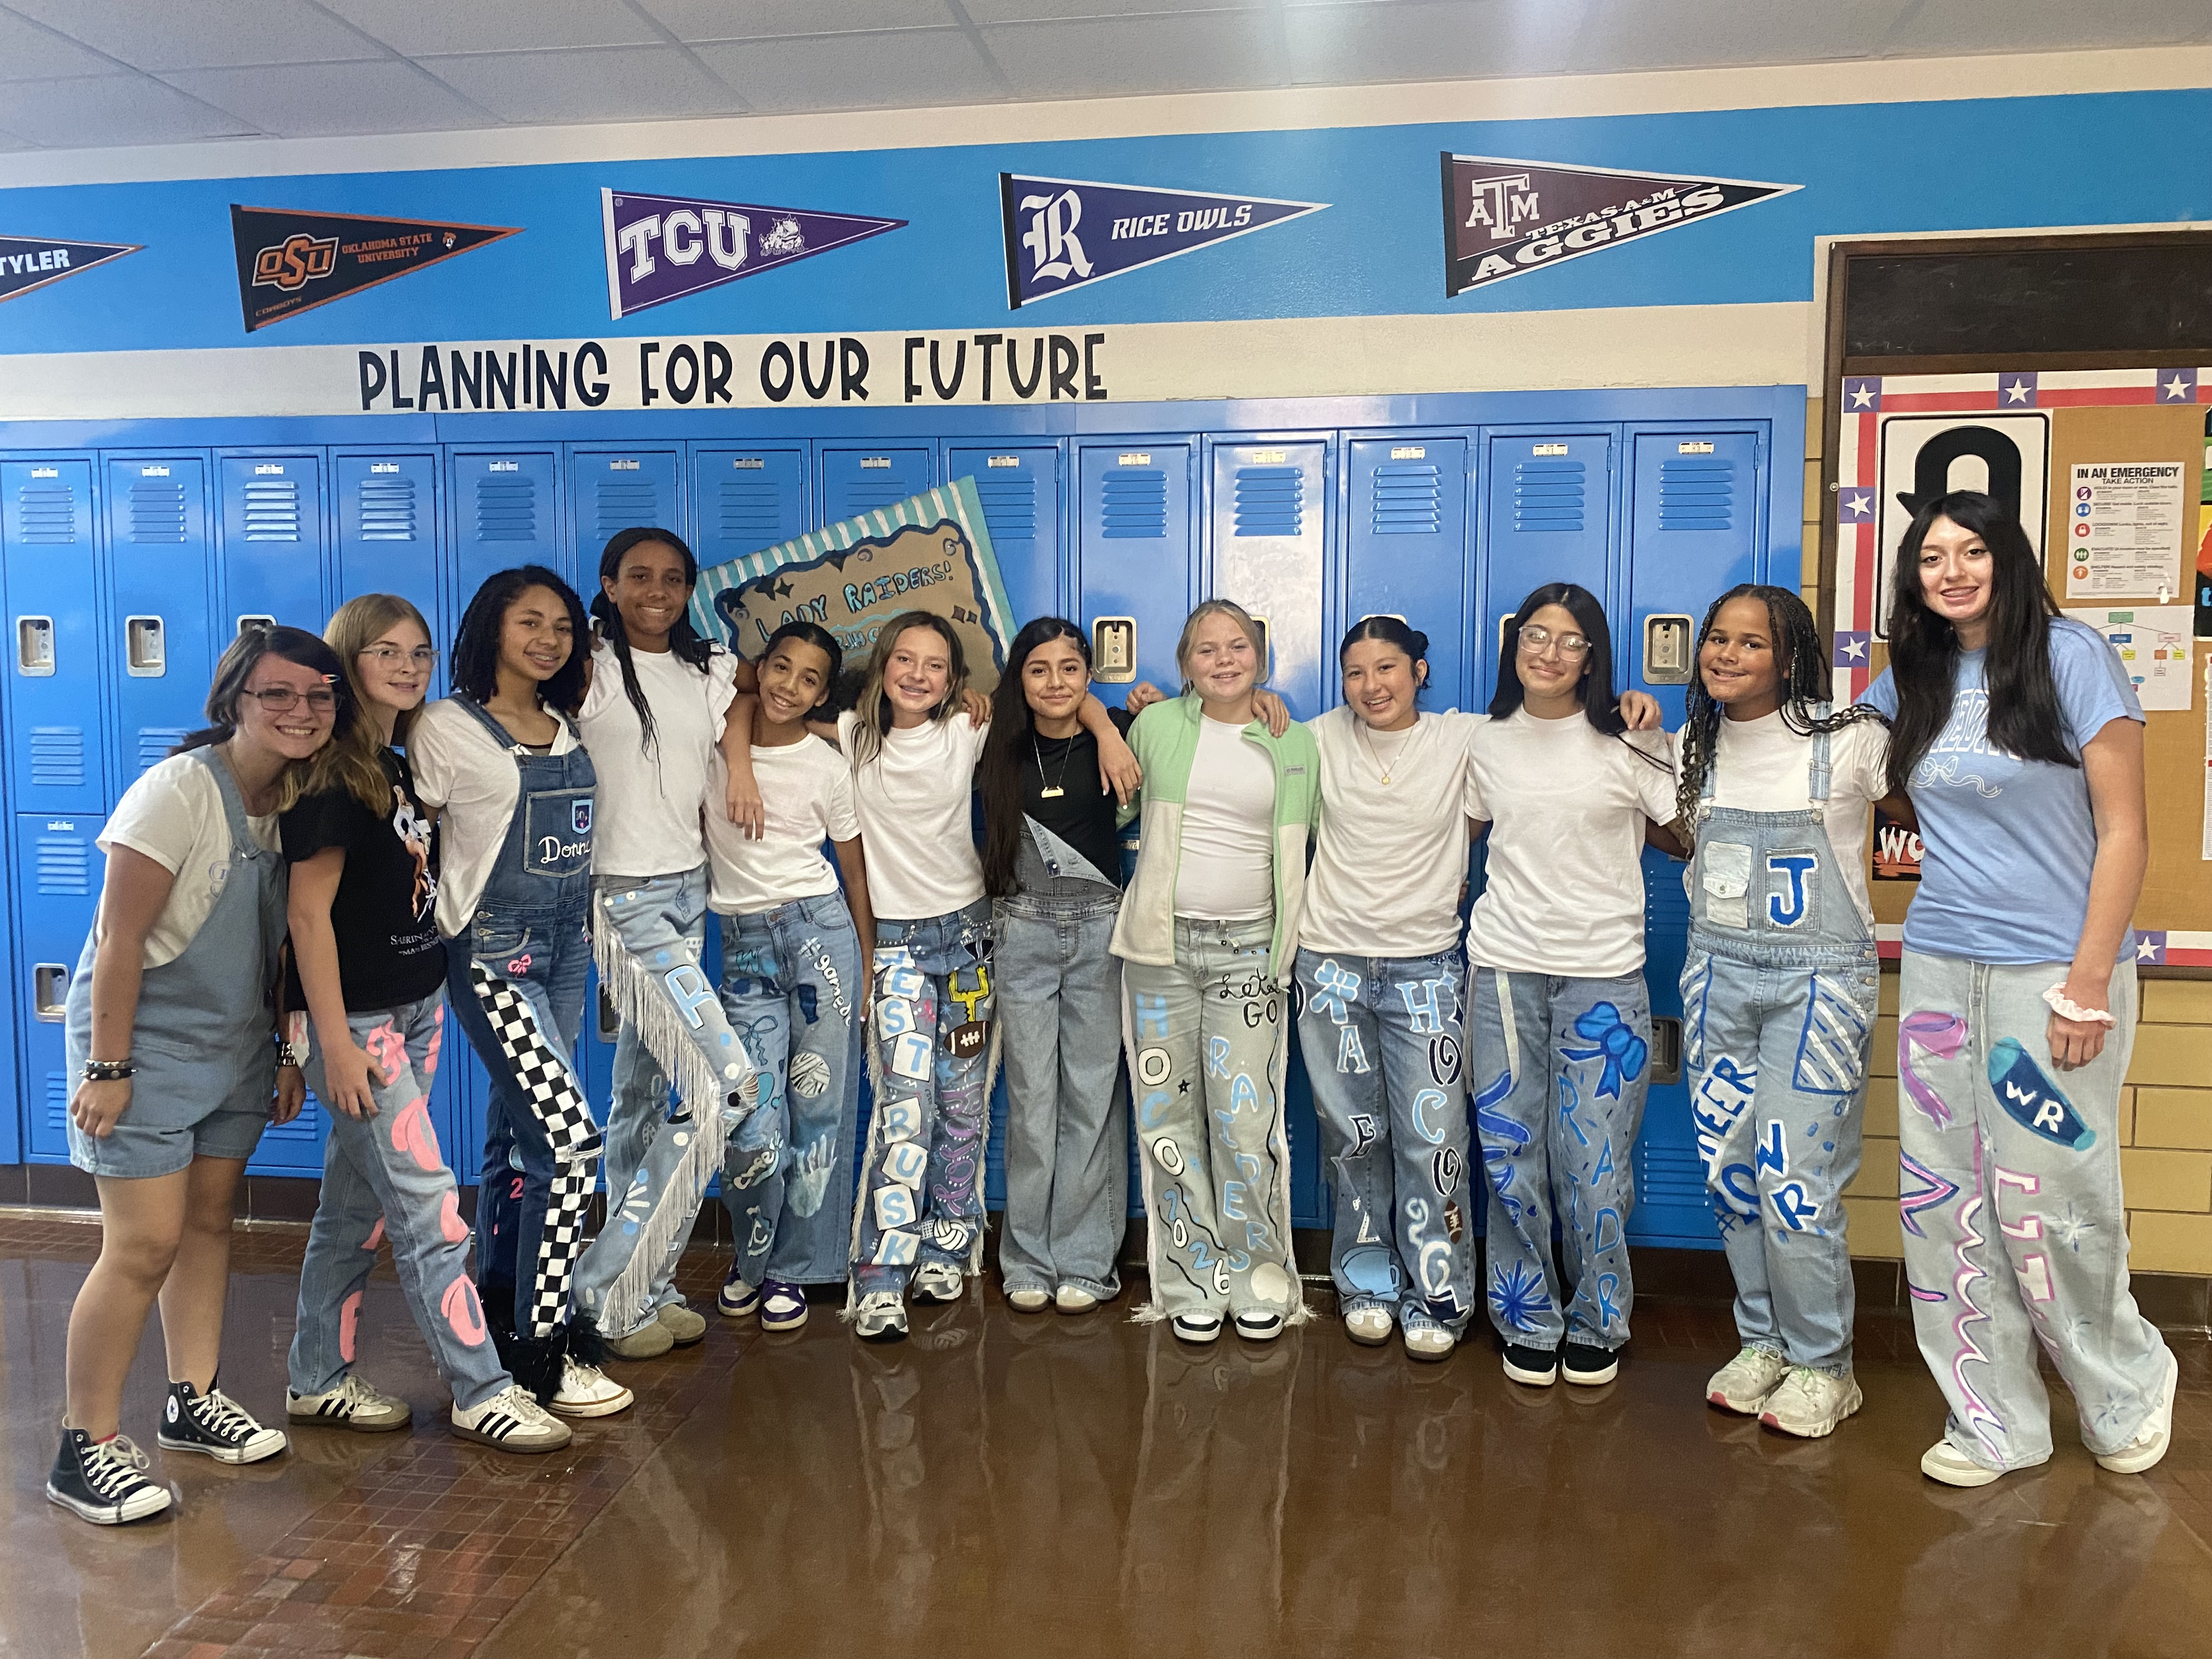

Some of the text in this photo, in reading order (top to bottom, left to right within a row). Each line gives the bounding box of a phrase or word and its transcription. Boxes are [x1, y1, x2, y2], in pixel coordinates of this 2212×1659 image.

[1111, 205, 1252, 240] RICE OWLS
[1471, 185, 1724, 281] AGGIES
[1525, 187, 1677, 240] TEXAS A&M
[255, 236, 336, 289] OSU
[342, 233, 433, 255] OKLAHOMA STATE
[358, 246, 419, 263] UNIVERSITY
[619, 209, 751, 284] TCU
[255, 296, 302, 317] COWBOYS
[358, 332, 1108, 411] PLANNING FOR OUR FUTURE
[2077, 466, 2180, 478] IN AN EMERGENCY
[755, 595, 828, 643] LADY
[843, 561, 954, 613] RAIDERS!
[1765, 854, 1819, 929] J
[664, 964, 724, 1030] R
[1243, 999, 1278, 1028] GO
[874, 949, 929, 1265] WEST RUSK
[1135, 994, 1186, 1176] HOCO
[2006, 1080, 2064, 1134] WR
